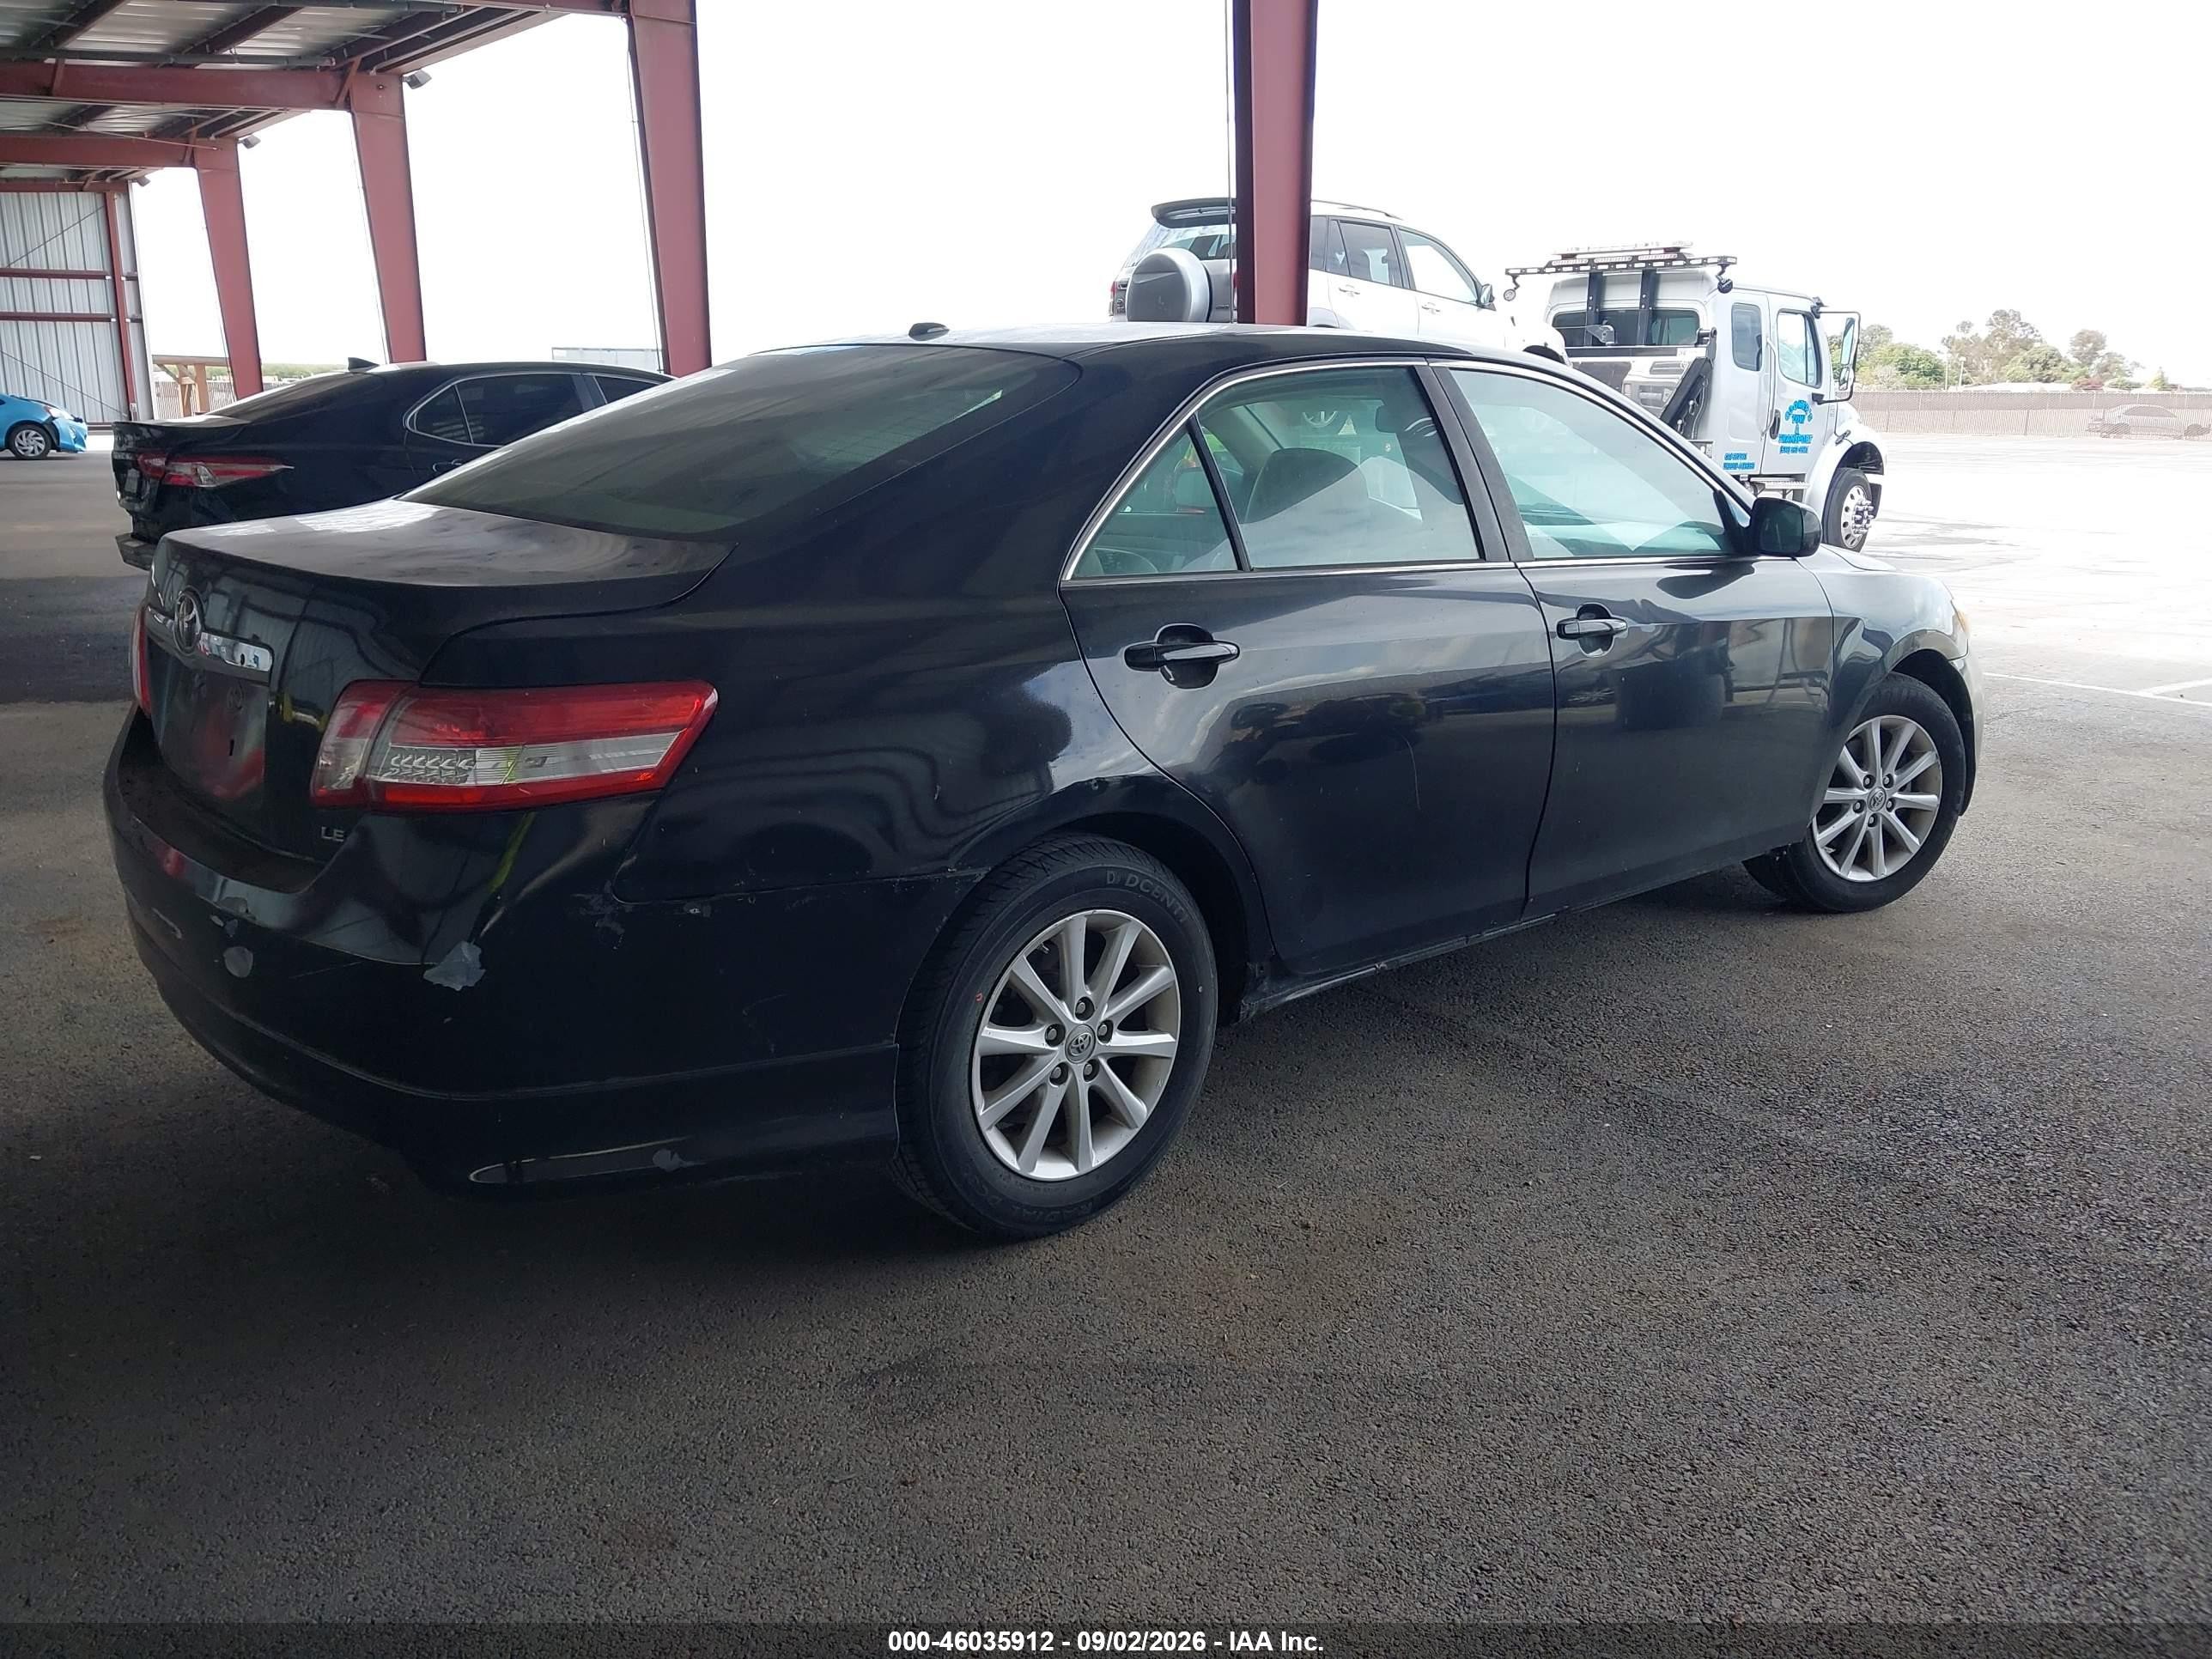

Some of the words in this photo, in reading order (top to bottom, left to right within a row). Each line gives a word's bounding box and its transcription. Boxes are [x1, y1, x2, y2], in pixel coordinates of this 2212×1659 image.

[1791, 414, 1806, 424] TOW
[1778, 434, 1814, 444] TRANSPORT
[321, 826, 344, 842] LE
